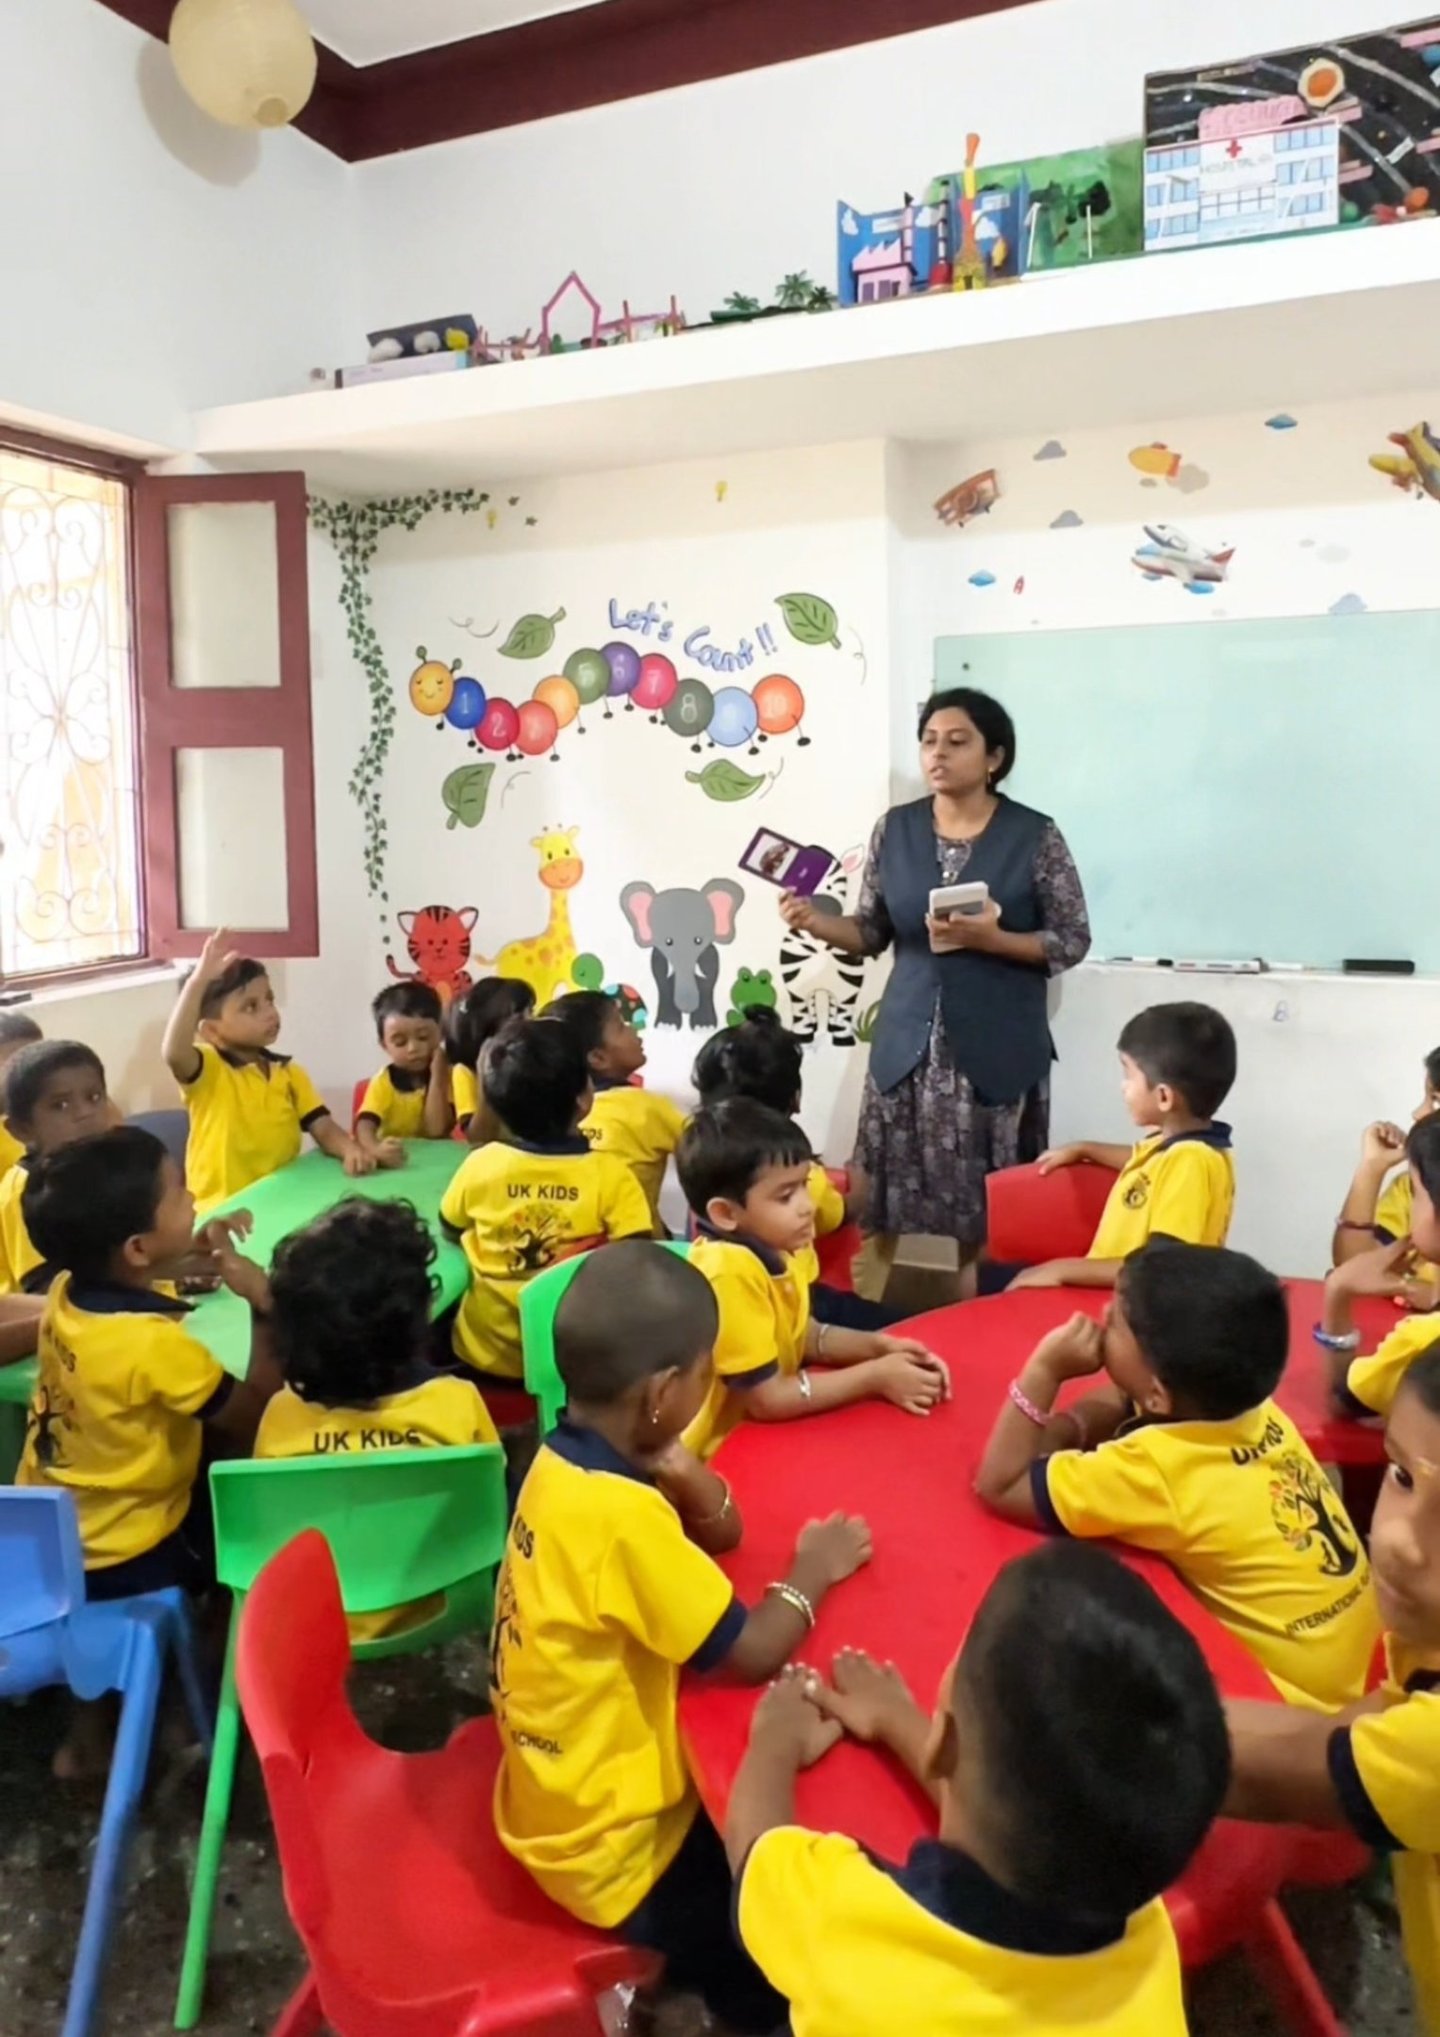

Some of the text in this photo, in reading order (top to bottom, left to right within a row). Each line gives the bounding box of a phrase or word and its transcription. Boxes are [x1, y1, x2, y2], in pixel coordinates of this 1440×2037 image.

[609, 598, 673, 642] Let's
[491, 711, 507, 738] 2
[681, 692, 698, 724] 8
[507, 1184, 579, 1201] UK KIDS
[314, 1428, 421, 1453] UK KIDS
